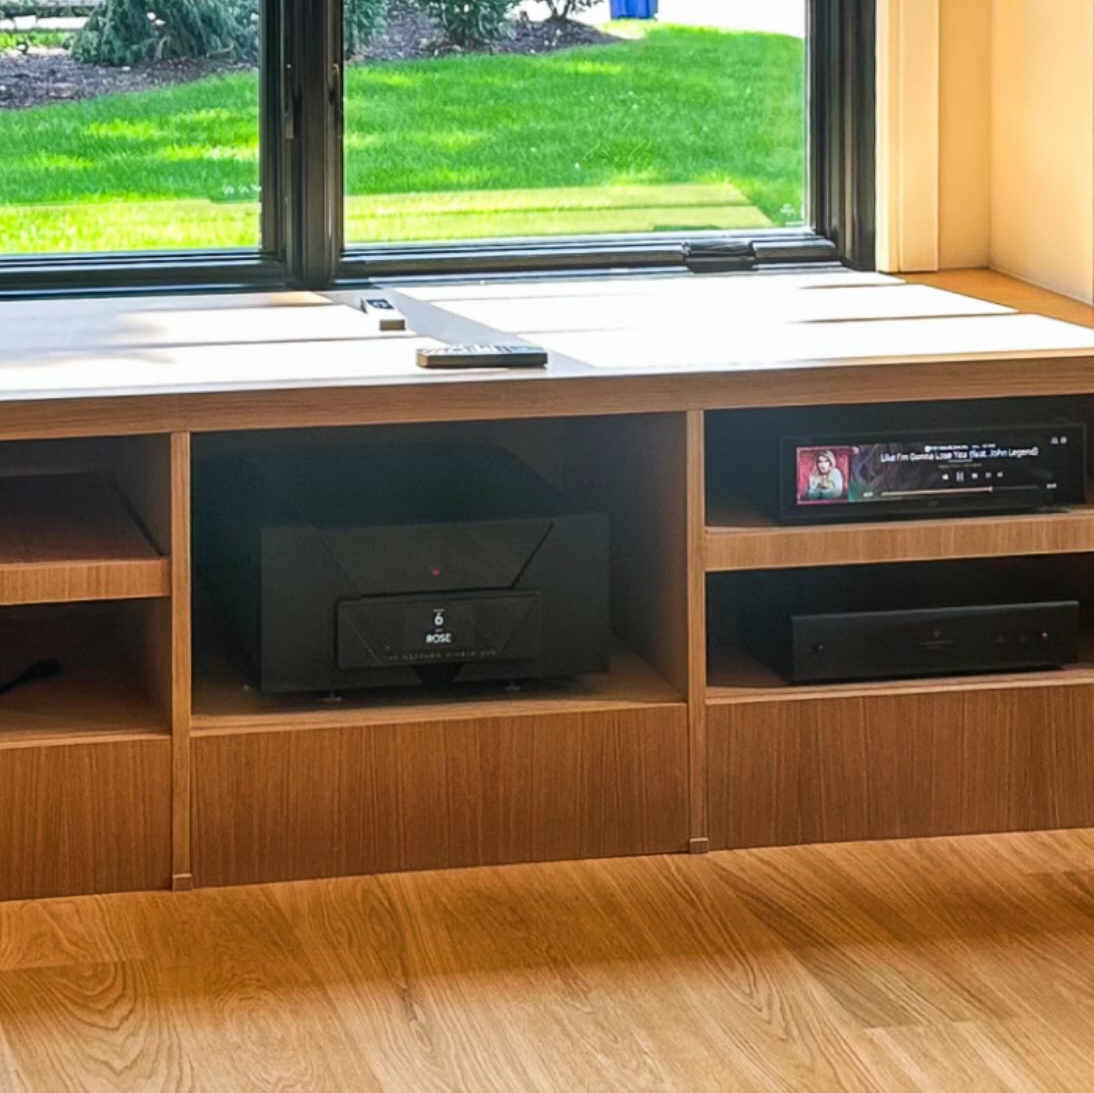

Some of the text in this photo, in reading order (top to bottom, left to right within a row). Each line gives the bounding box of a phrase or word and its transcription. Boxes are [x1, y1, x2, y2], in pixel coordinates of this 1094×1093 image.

[880, 452, 896, 463] Like
[896, 452, 909, 462] I'm
[909, 452, 934, 462] Gonna
[935, 451, 953, 461] Lose
[953, 450, 968, 459] You
[989, 448, 1008, 458] John
[1008, 446, 1039, 459] Legend)
[425, 633, 453, 644] ROSE
